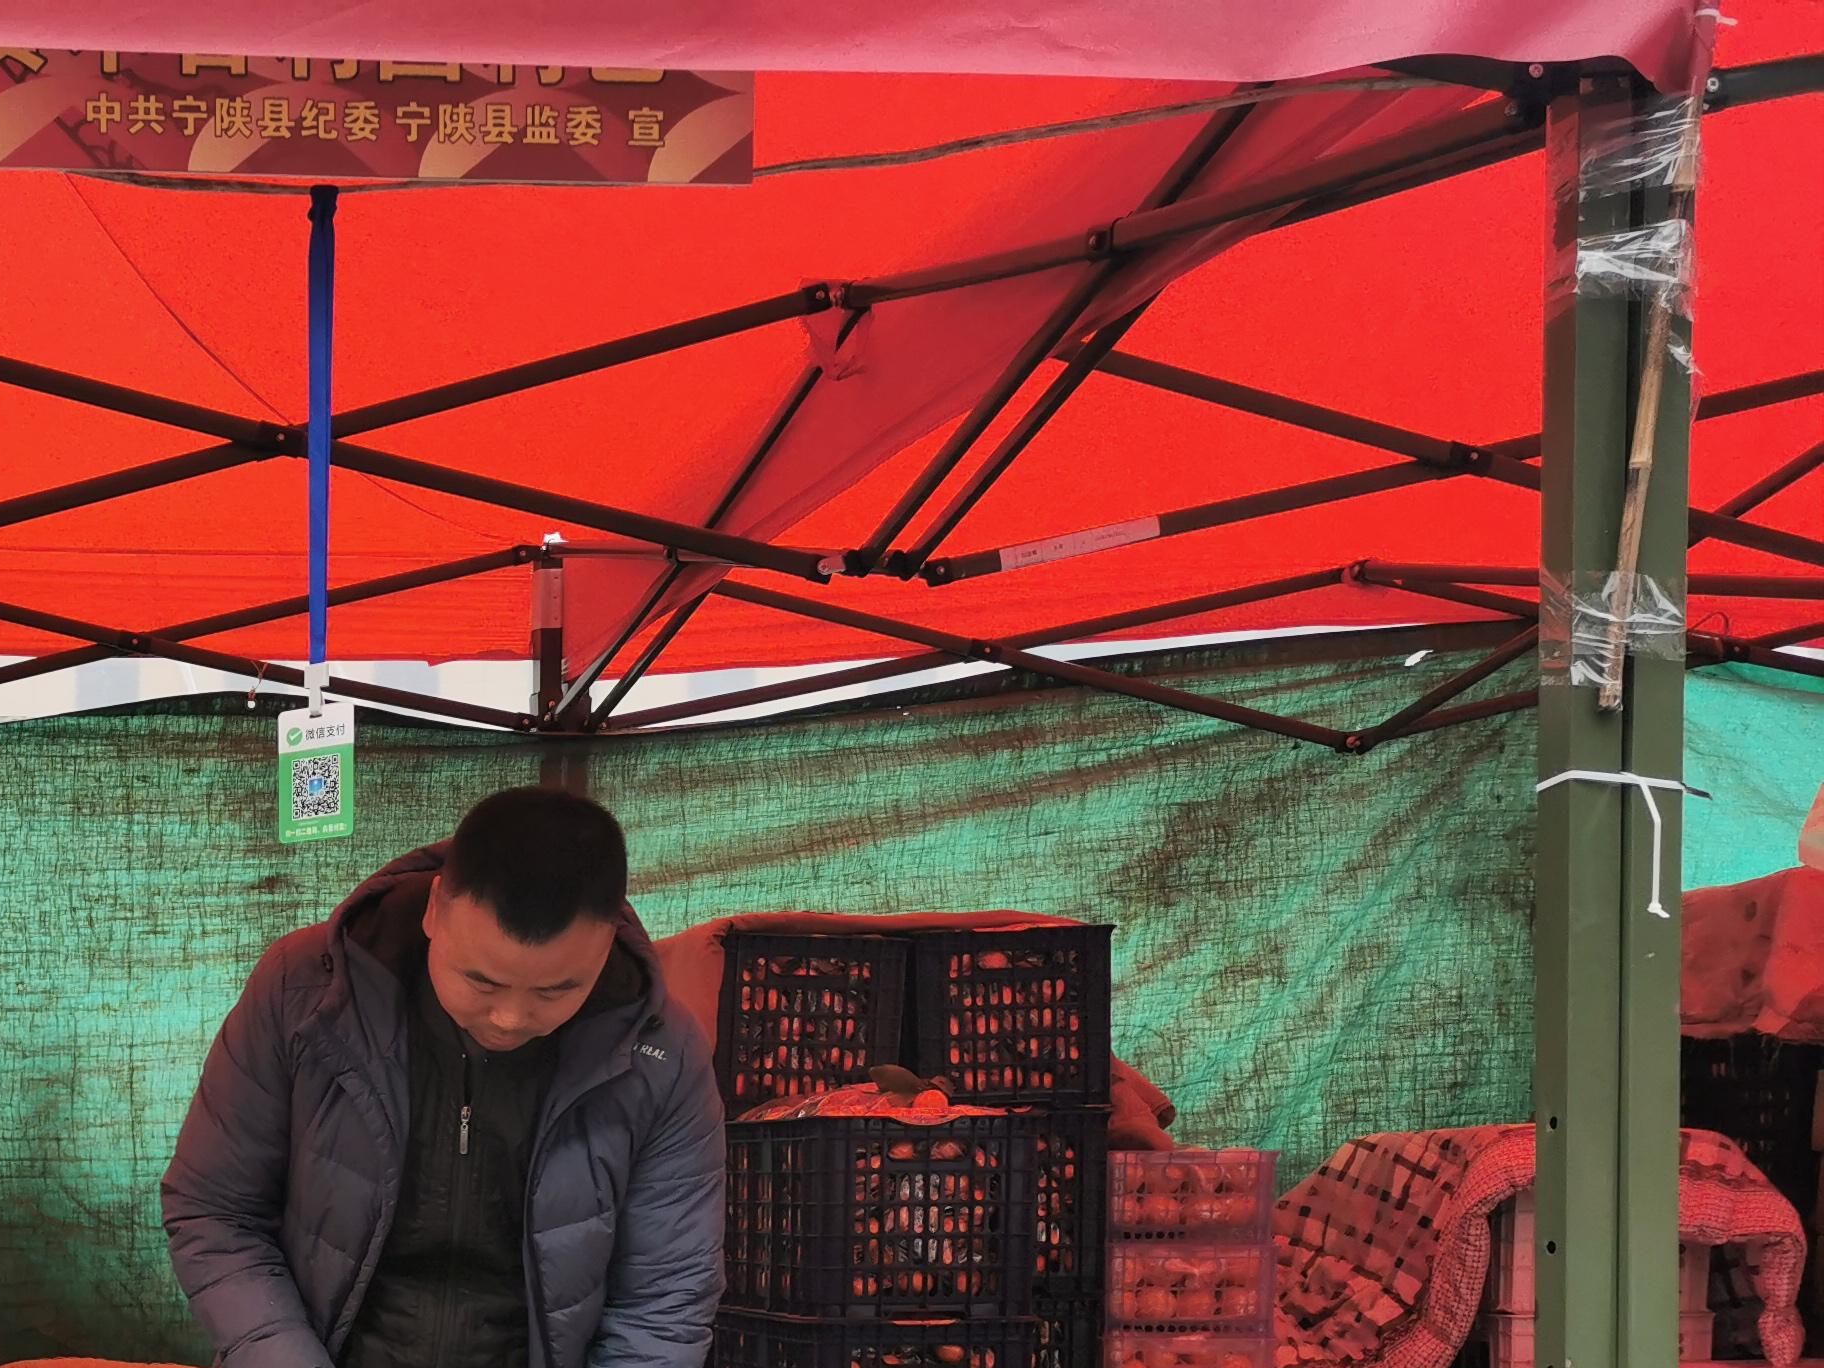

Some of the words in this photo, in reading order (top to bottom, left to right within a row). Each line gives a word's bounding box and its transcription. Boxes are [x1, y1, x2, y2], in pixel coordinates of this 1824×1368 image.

[86, 91, 381, 142] 中共宁陕县纪委
[395, 101, 603, 148] 宁陕县监委
[628, 106, 666, 148] 宣
[305, 724, 346, 741] 微信支付
